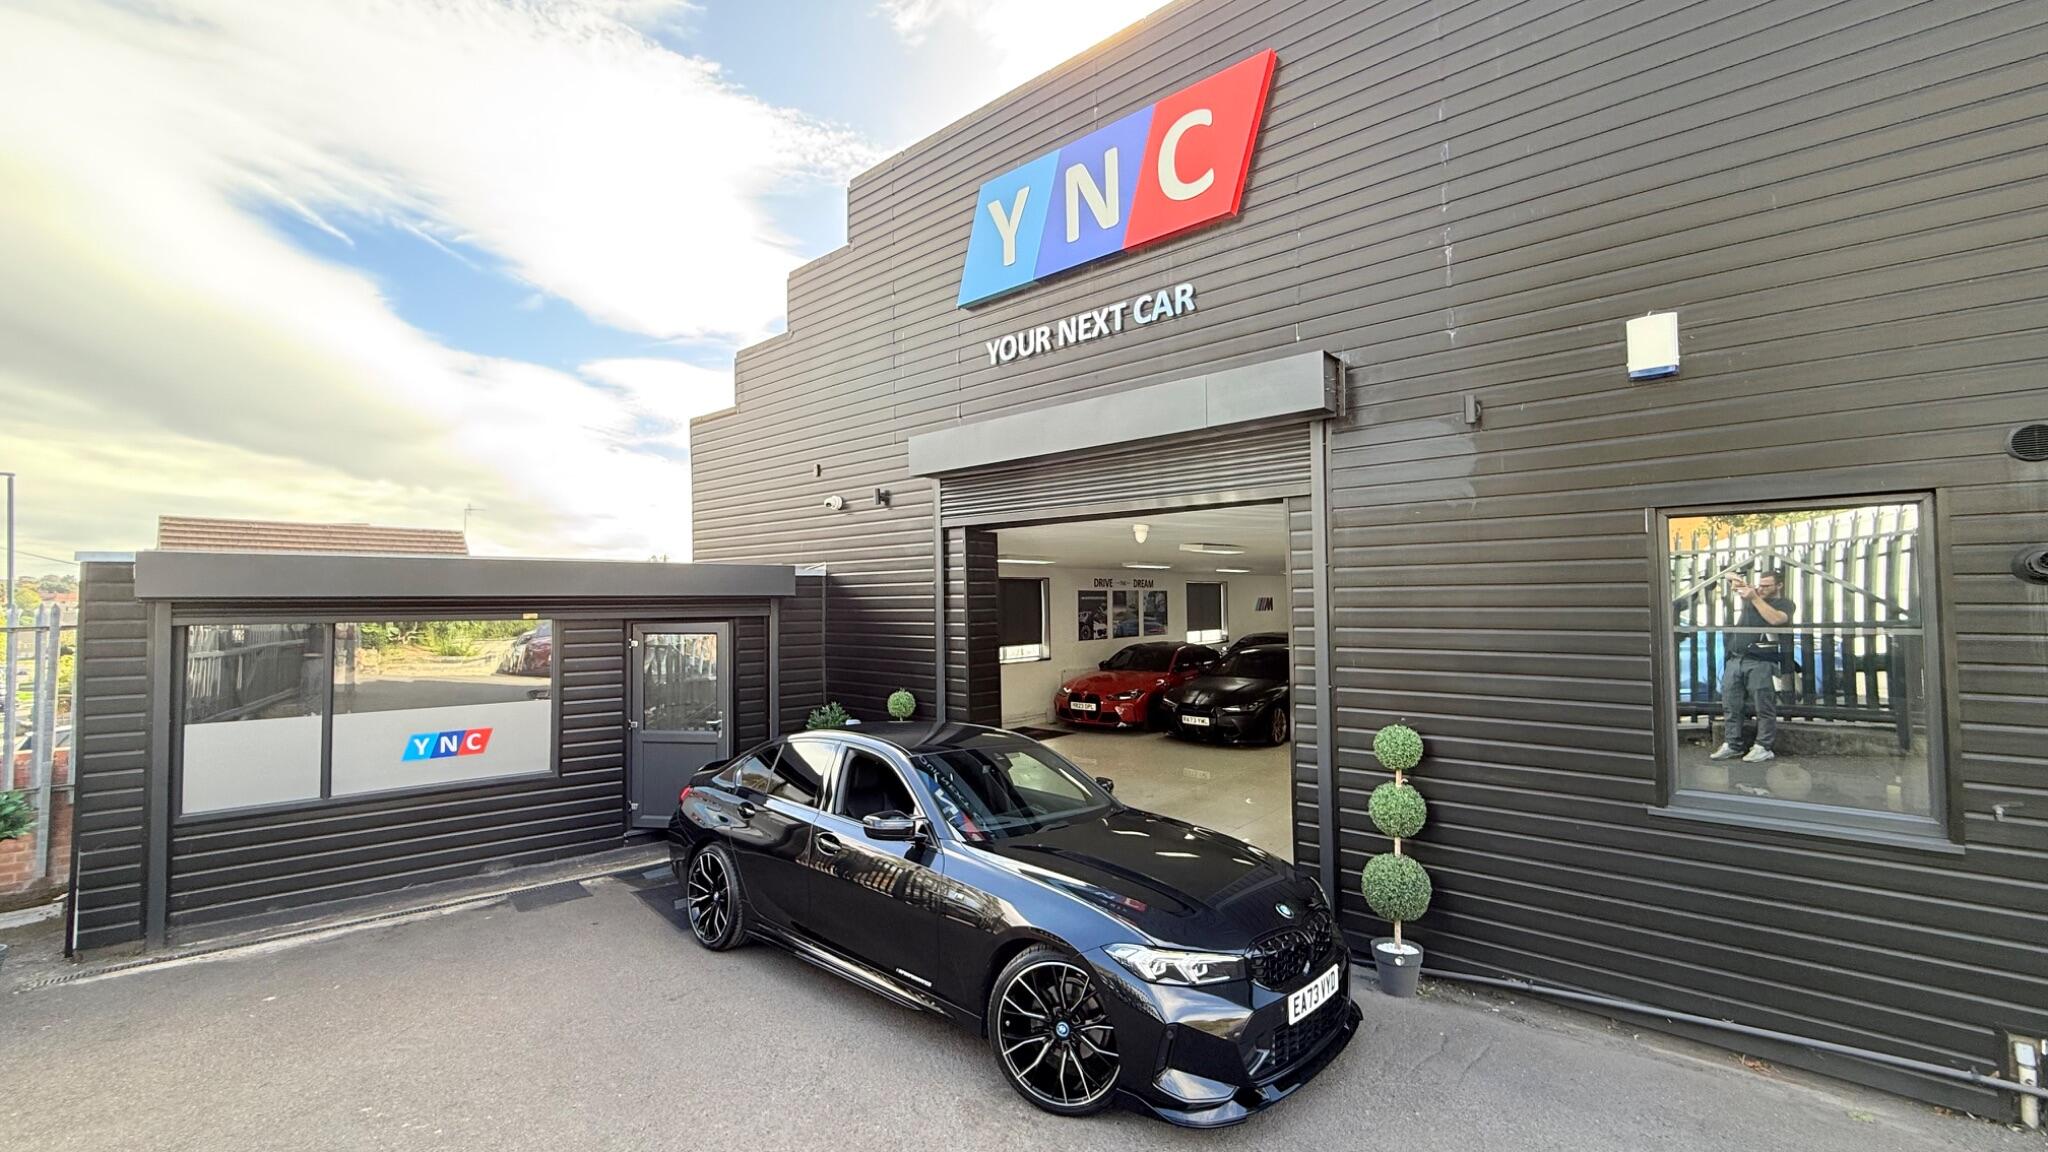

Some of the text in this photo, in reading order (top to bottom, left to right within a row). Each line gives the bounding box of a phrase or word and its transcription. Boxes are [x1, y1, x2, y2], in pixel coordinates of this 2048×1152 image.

[987, 108, 1214, 267] YNC
[985, 283, 1196, 365] YOUR NEXT CAR
[1093, 578, 1113, 588] DRIVE
[1133, 579, 1154, 588] DREAM
[413, 733, 482, 756] YNC
[1293, 970, 1336, 1018] EA73 VYD
